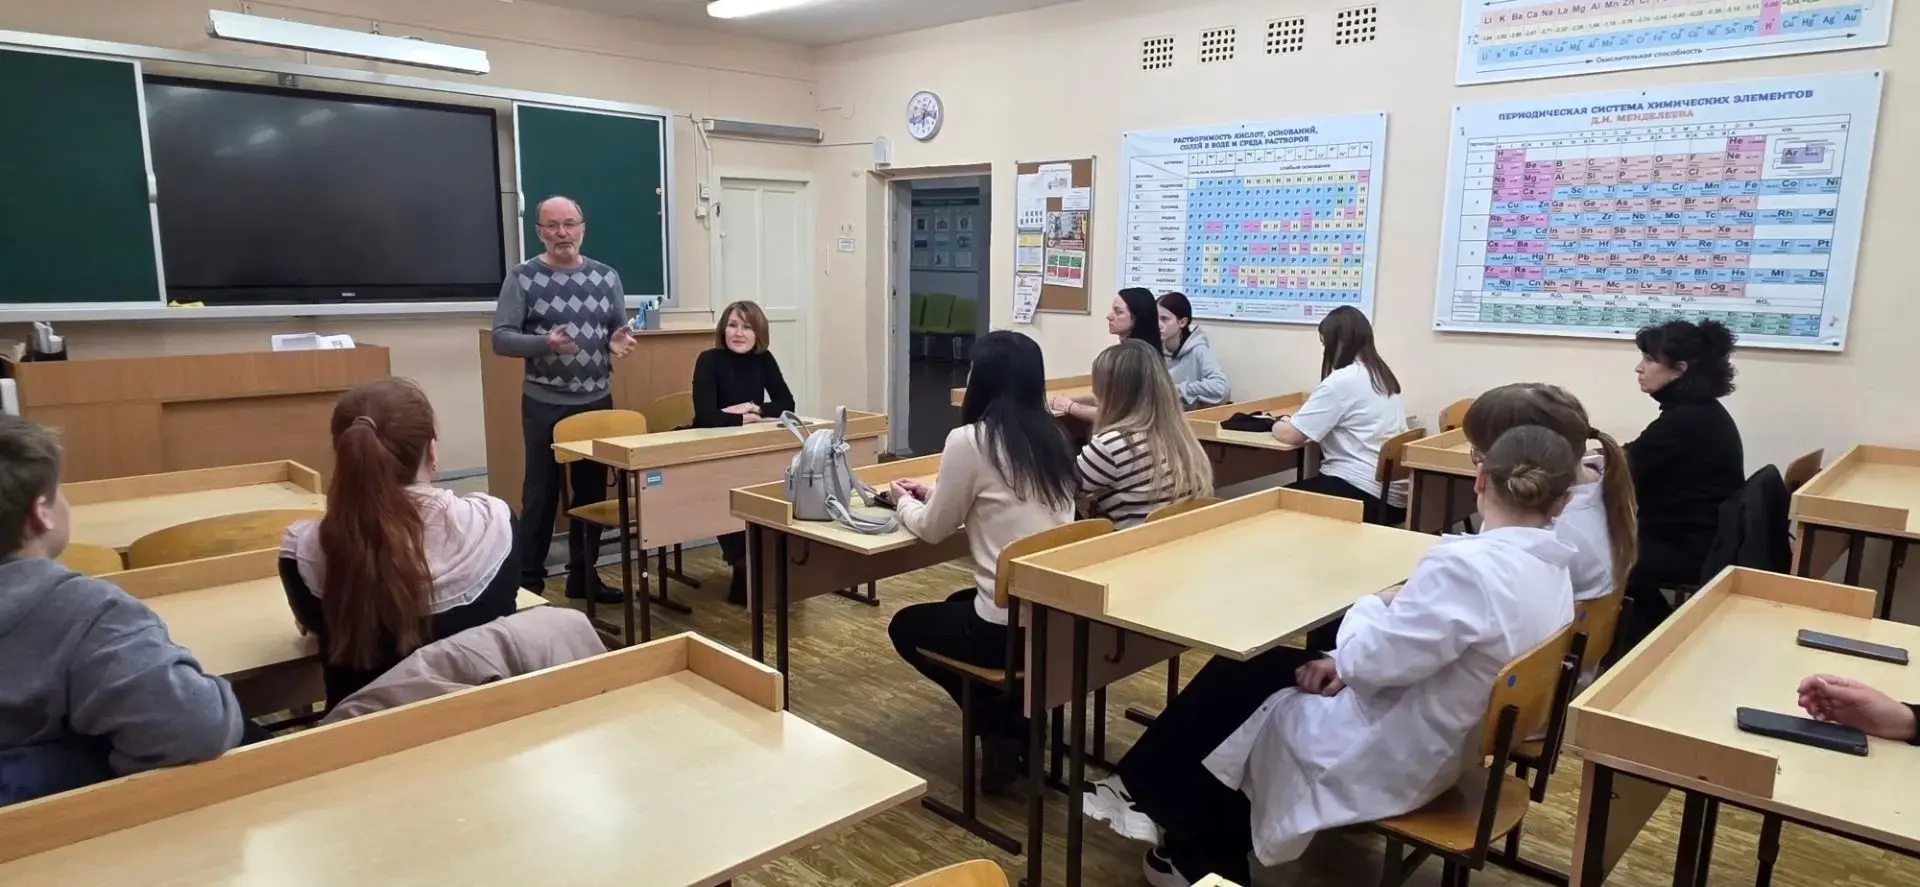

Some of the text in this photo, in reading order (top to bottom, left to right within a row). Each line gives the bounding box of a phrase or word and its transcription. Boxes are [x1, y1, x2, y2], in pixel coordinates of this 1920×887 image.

[1527, 11, 1538, 19] Ca
[1590, 2, 1600, 10] Al
[1655, 48, 1702, 58] способность
[1499, 90, 1814, 120] ПЕРИОДИЧЕСКАЯ СИСТЕМА ХИМИЧЕСКИХ ЭЛЕМЕНТОВ
[1591, 111, 1694, 124] Д.И. МЕНДЕЛЕЕВА
[1173, 126, 1318, 143] РАСТВОРИМОСТЬ КИСЛОТ, ОСНОВАНИЙ,
[1265, 137, 1309, 145] РАСТВОРОВ
[1726, 152, 1740, 160] Ne
[1524, 175, 1537, 183] Mg
[1818, 209, 1833, 217] Pd
[1711, 283, 1725, 291] Og
